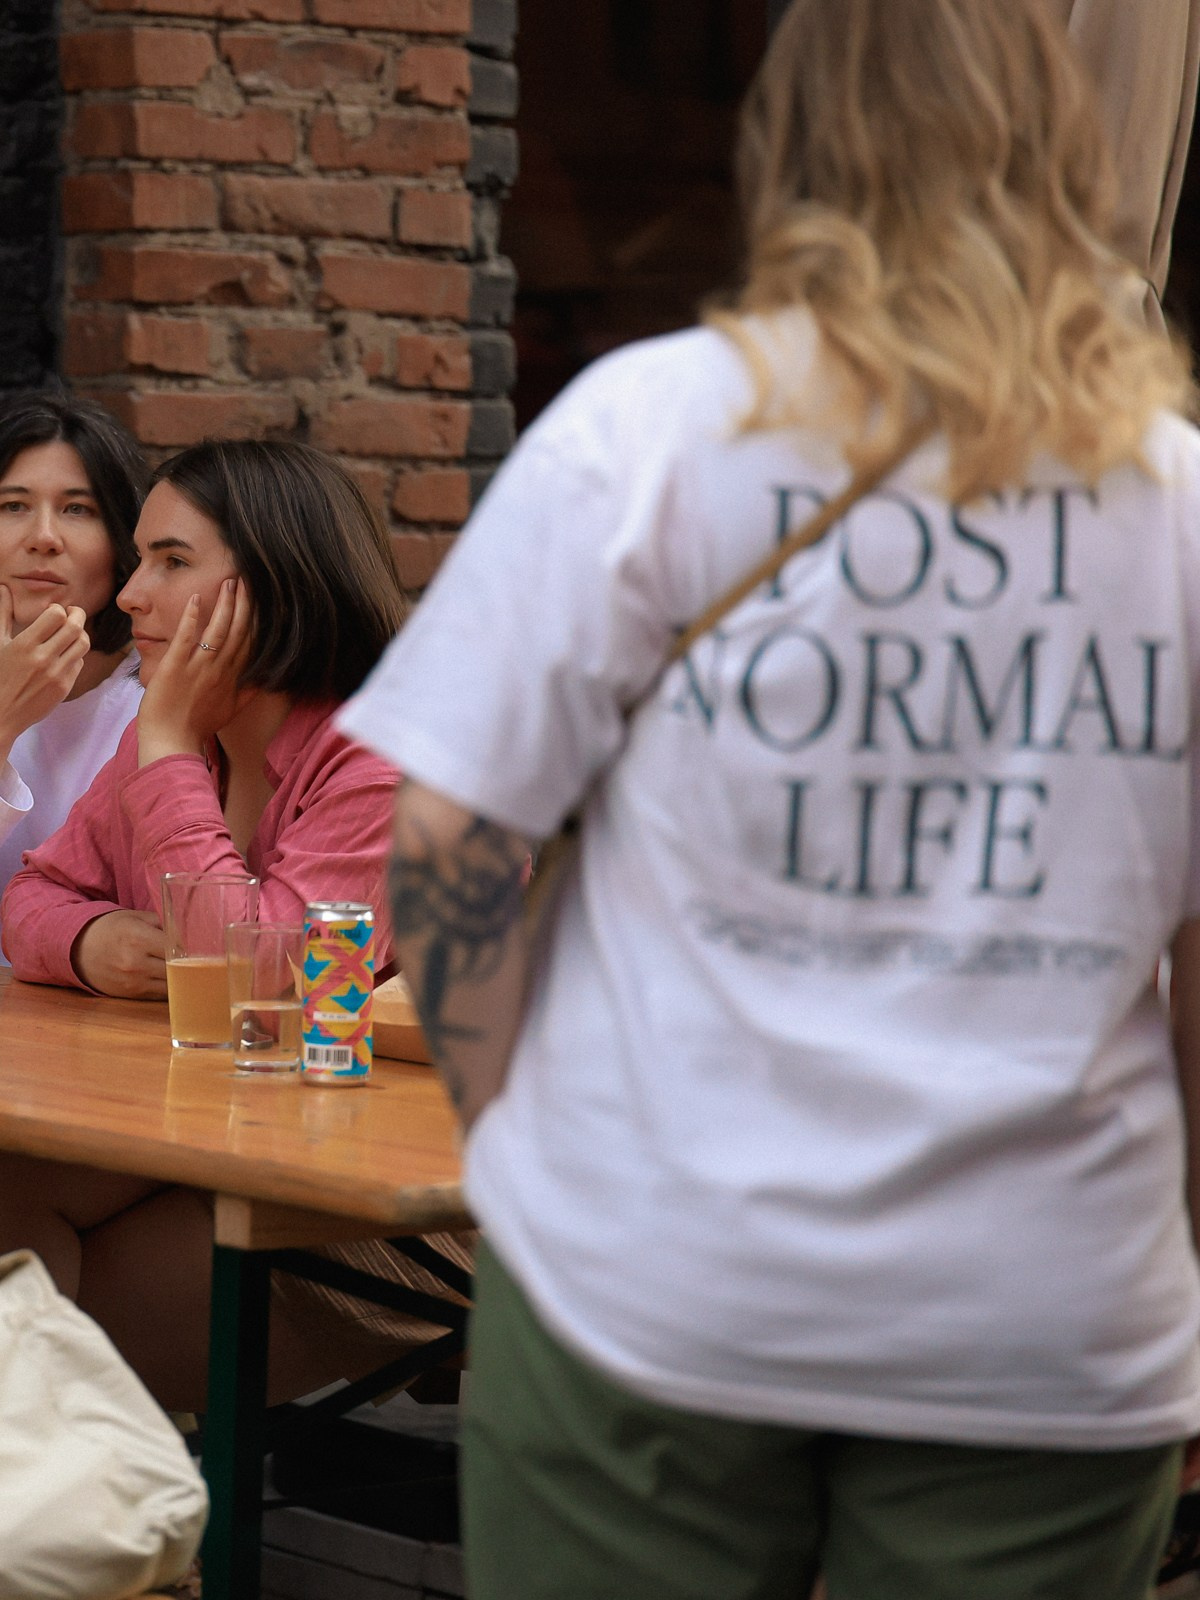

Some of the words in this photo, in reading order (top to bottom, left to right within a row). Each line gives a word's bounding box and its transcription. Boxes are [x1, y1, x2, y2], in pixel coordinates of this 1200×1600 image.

[768, 483, 1100, 610] POST
[672, 622, 1183, 762] NORMAL
[781, 776, 1049, 898] LIFE
